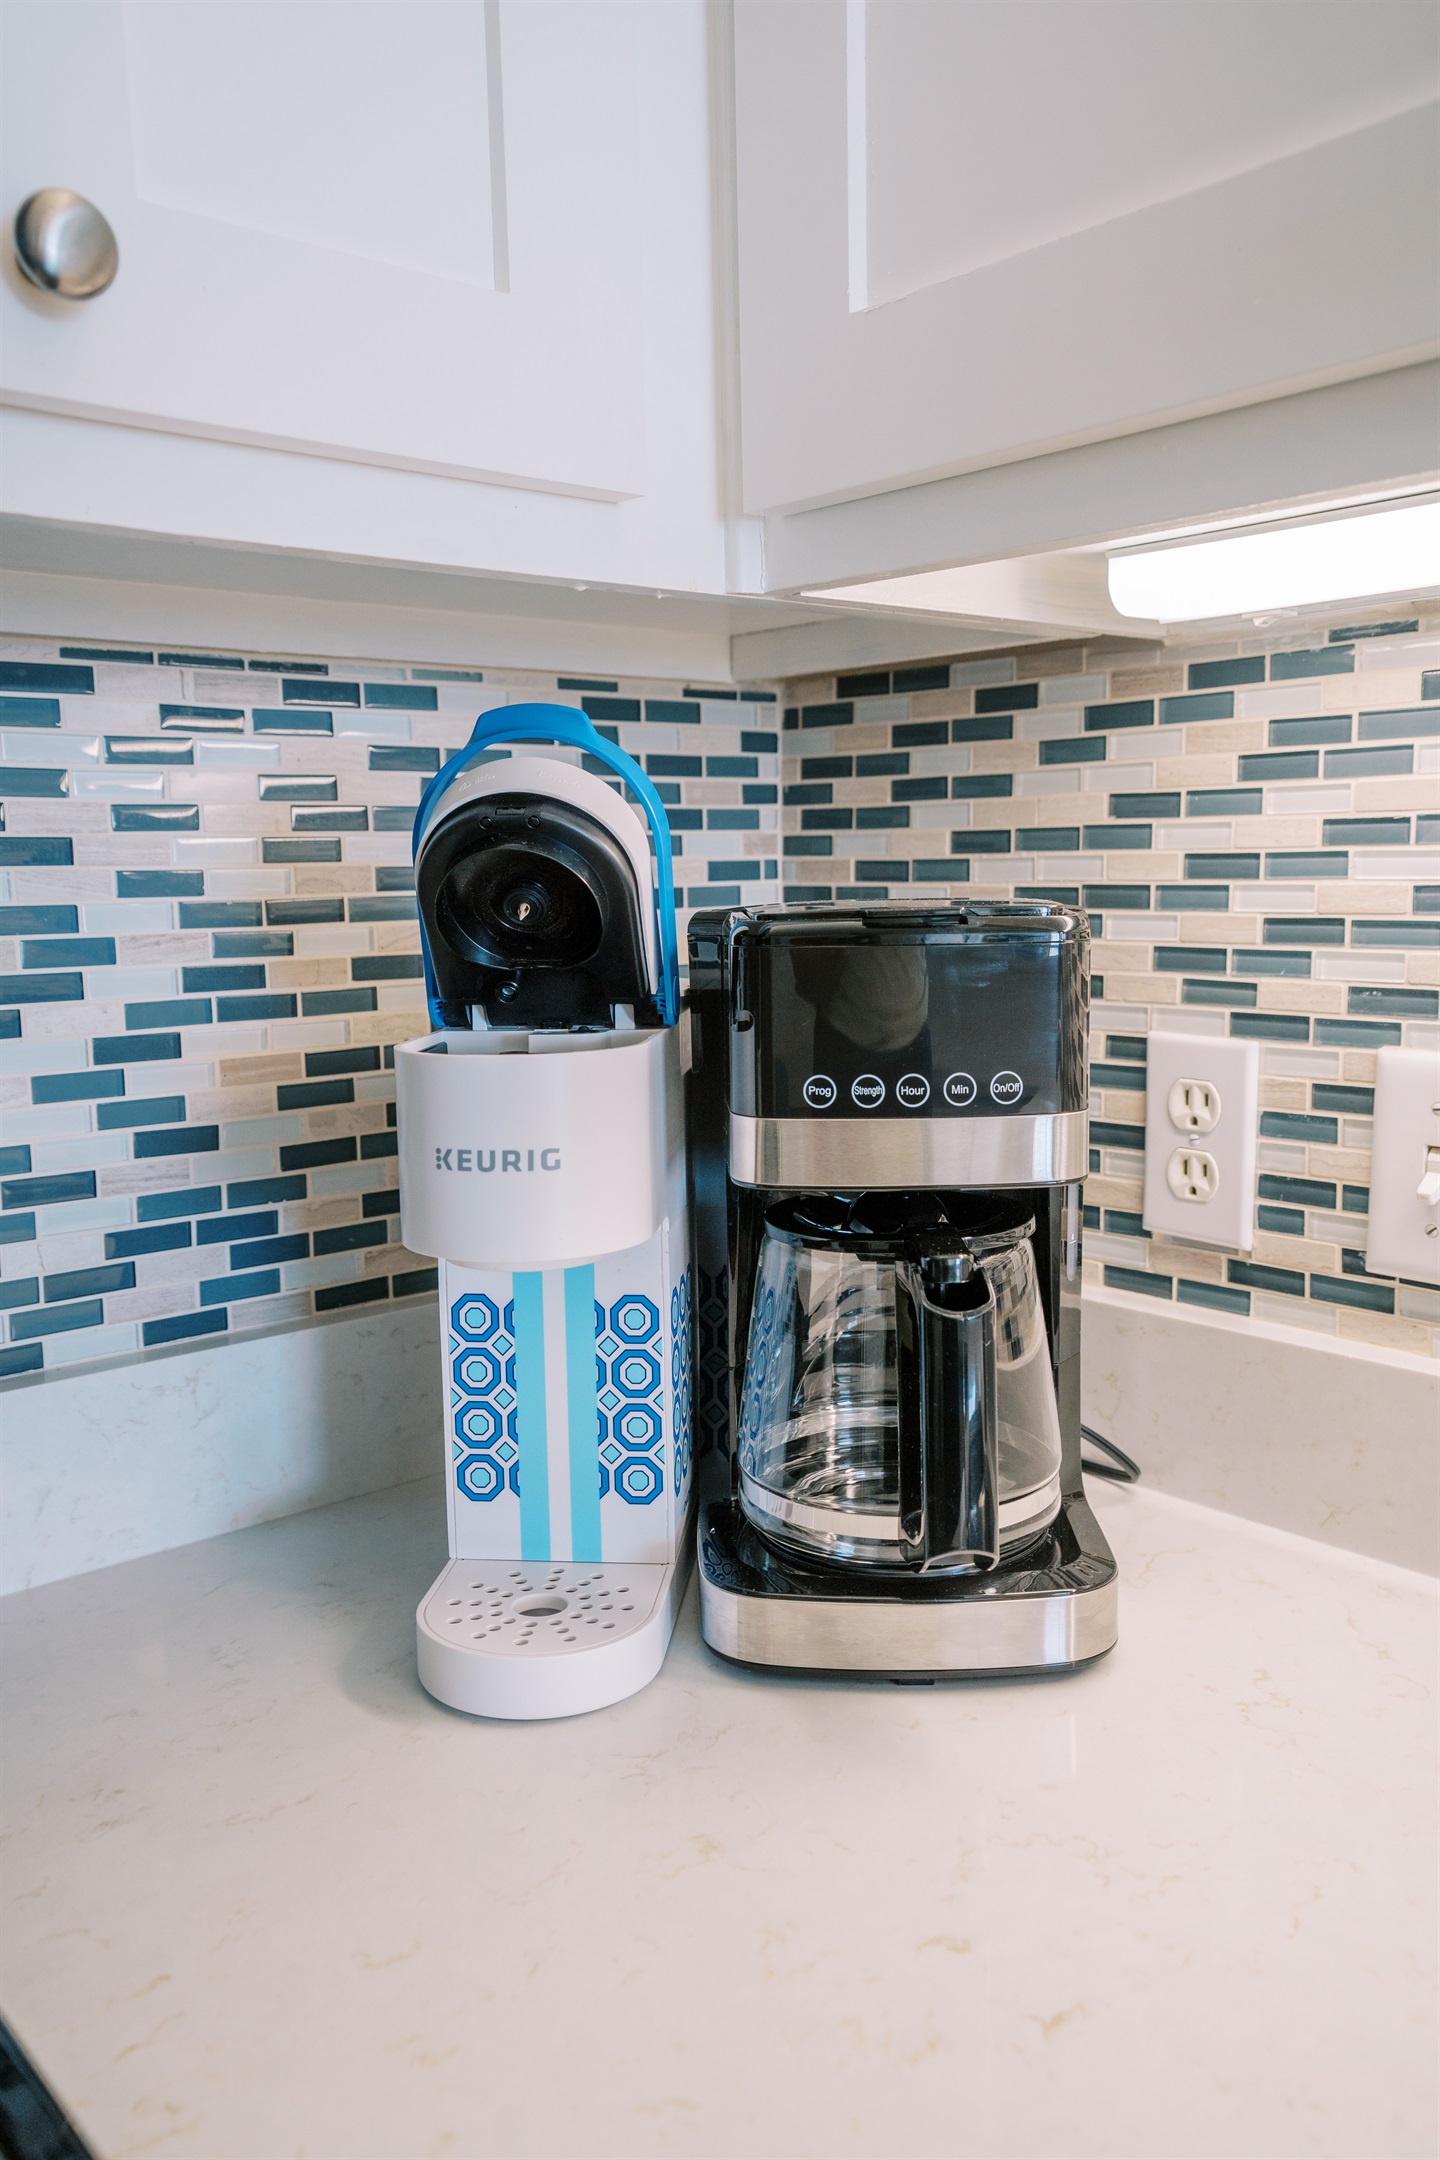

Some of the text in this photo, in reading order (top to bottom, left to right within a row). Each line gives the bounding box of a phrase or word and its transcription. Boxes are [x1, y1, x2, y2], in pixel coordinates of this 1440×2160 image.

[808, 1086, 832, 1097] Prog
[854, 1085, 883, 1096] Strength
[900, 1086, 925, 1095] Hour
[951, 1085, 969, 1094] Min
[993, 1082, 1021, 1093] On/Off
[435, 1147, 561, 1173] KEURIG
